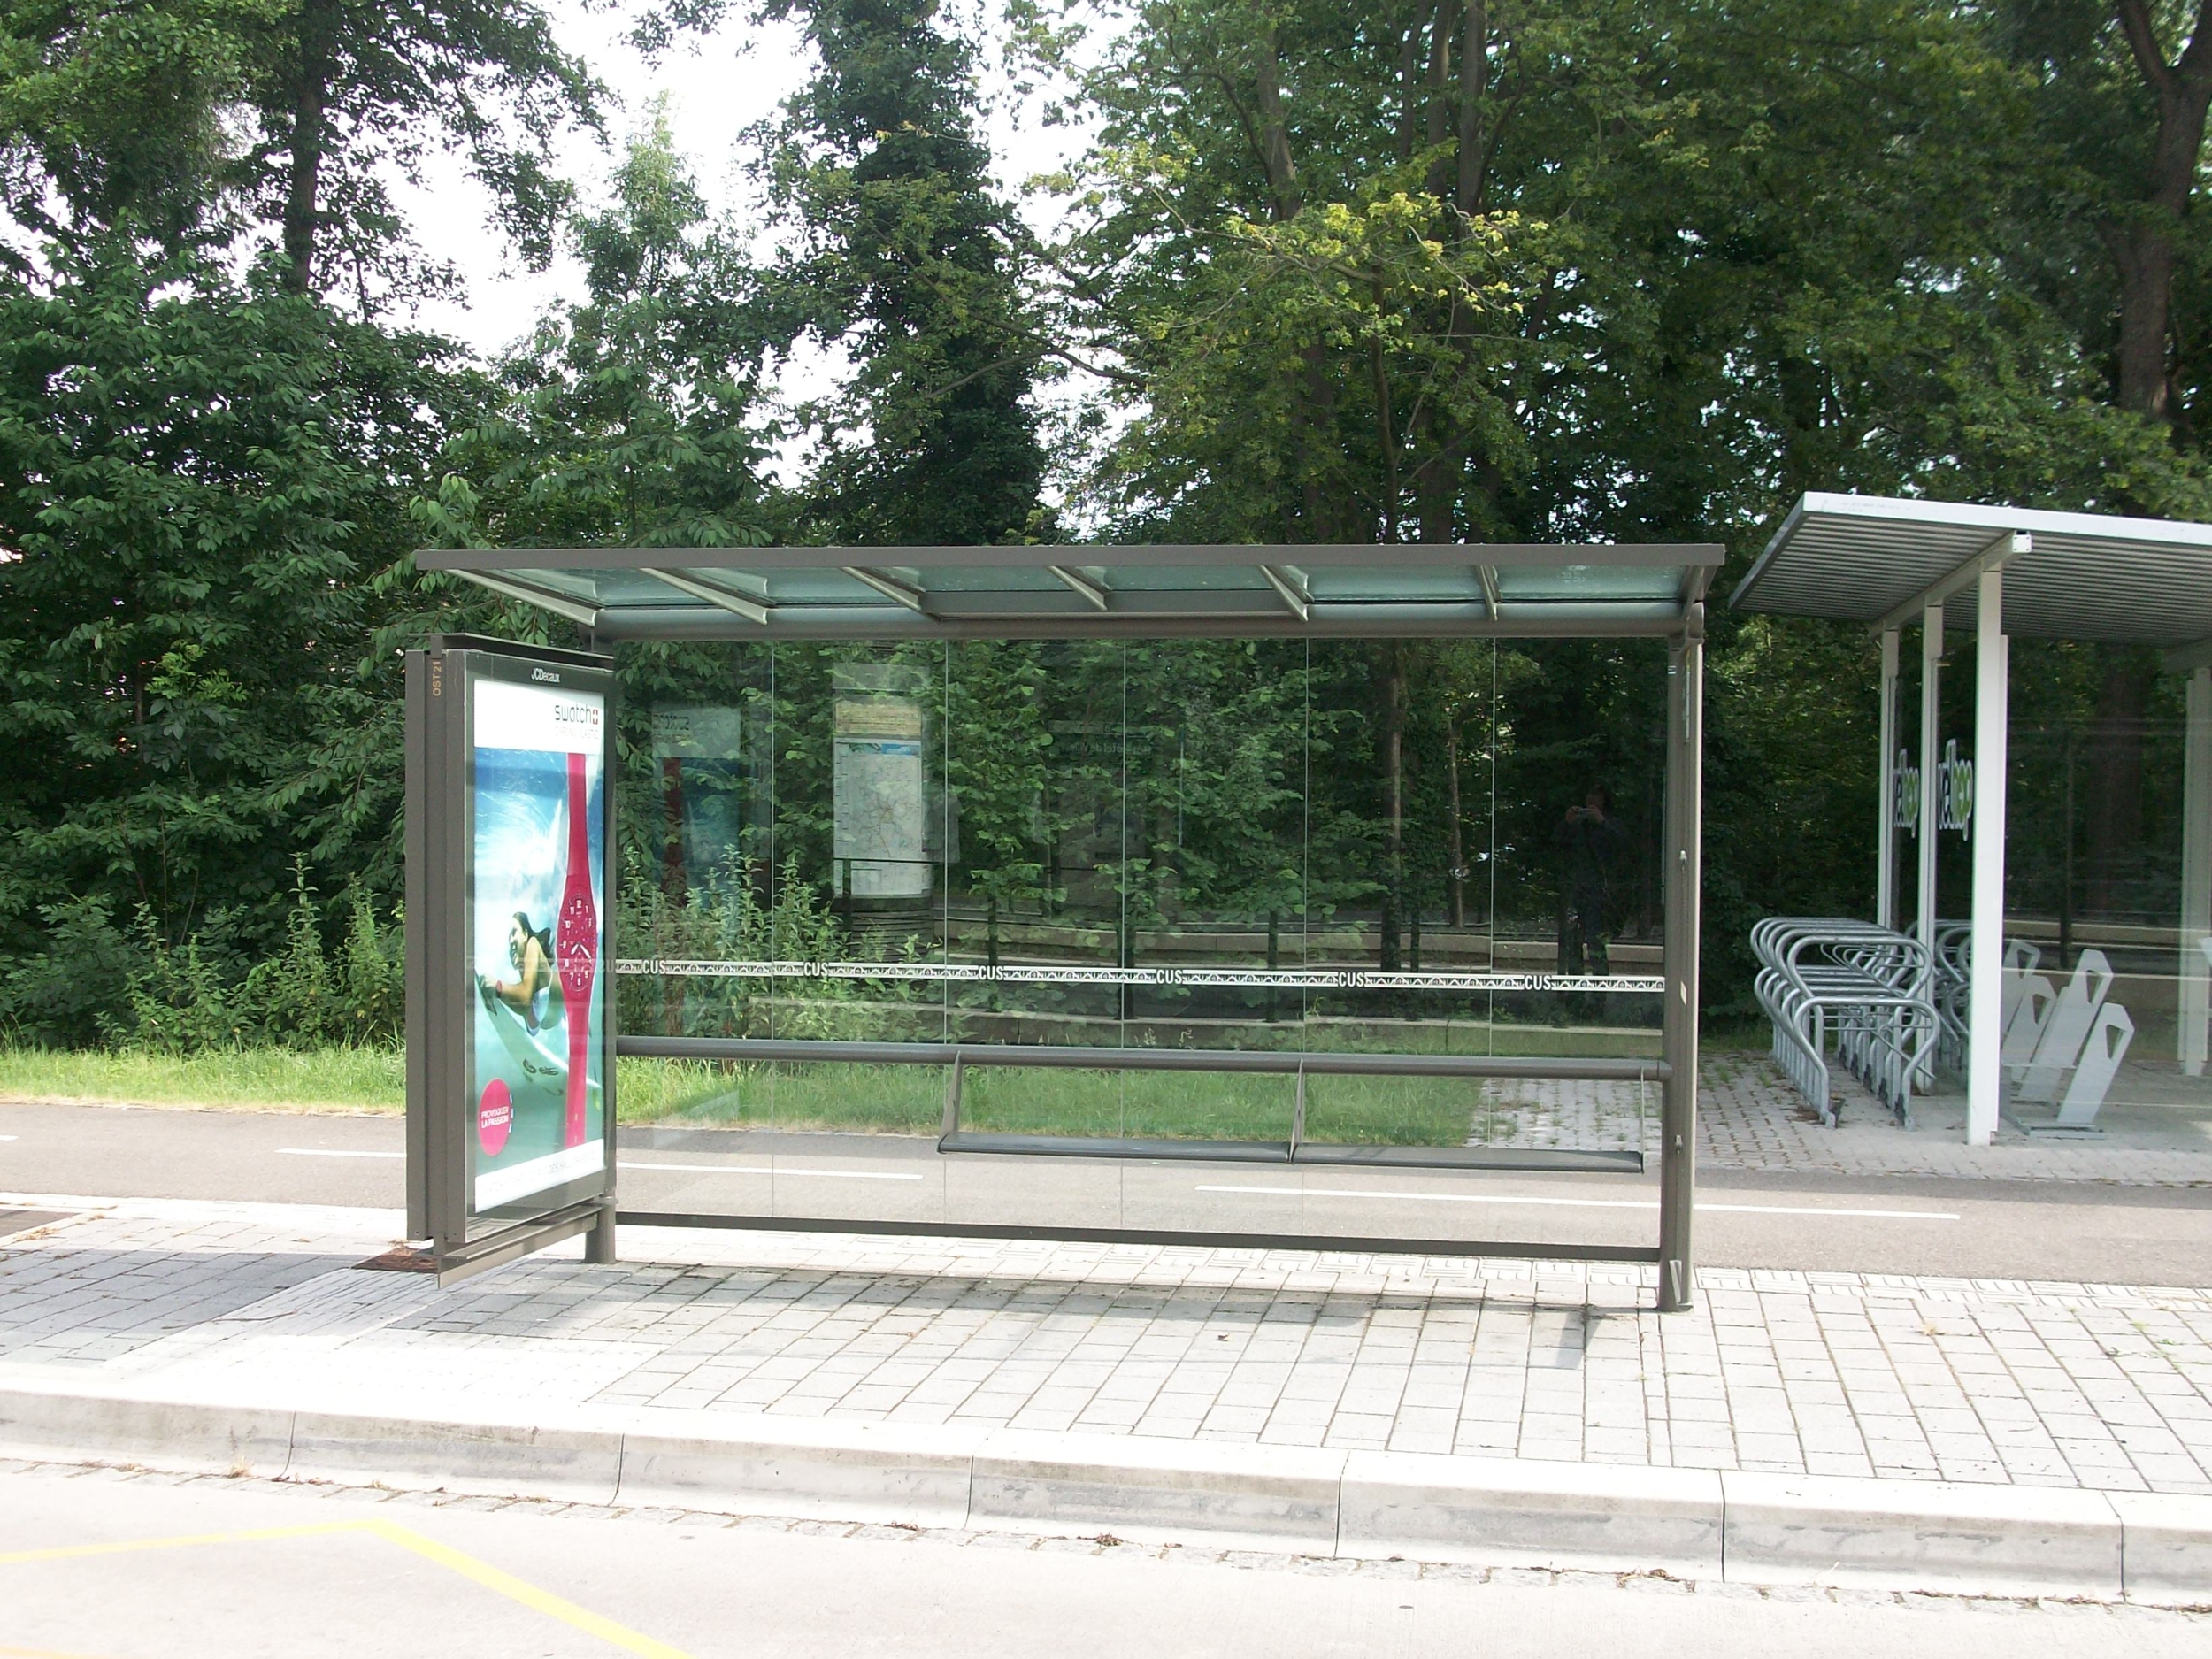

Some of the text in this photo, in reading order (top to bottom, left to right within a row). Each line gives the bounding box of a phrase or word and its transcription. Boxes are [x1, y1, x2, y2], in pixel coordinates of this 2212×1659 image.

[531, 667, 560, 683] JCDecaux
[555, 703, 592, 724] swatch
[642, 959, 665, 974] CUS
[804, 962, 828, 977] CUS
[979, 965, 1003, 980] CUS
[1156, 969, 1183, 984] CUS
[1339, 972, 1364, 987] CUS
[1525, 975, 1551, 990] CUS
[480, 1105, 509, 1119] PROVOQUER
[480, 1115, 509, 1129] LA PASSION
